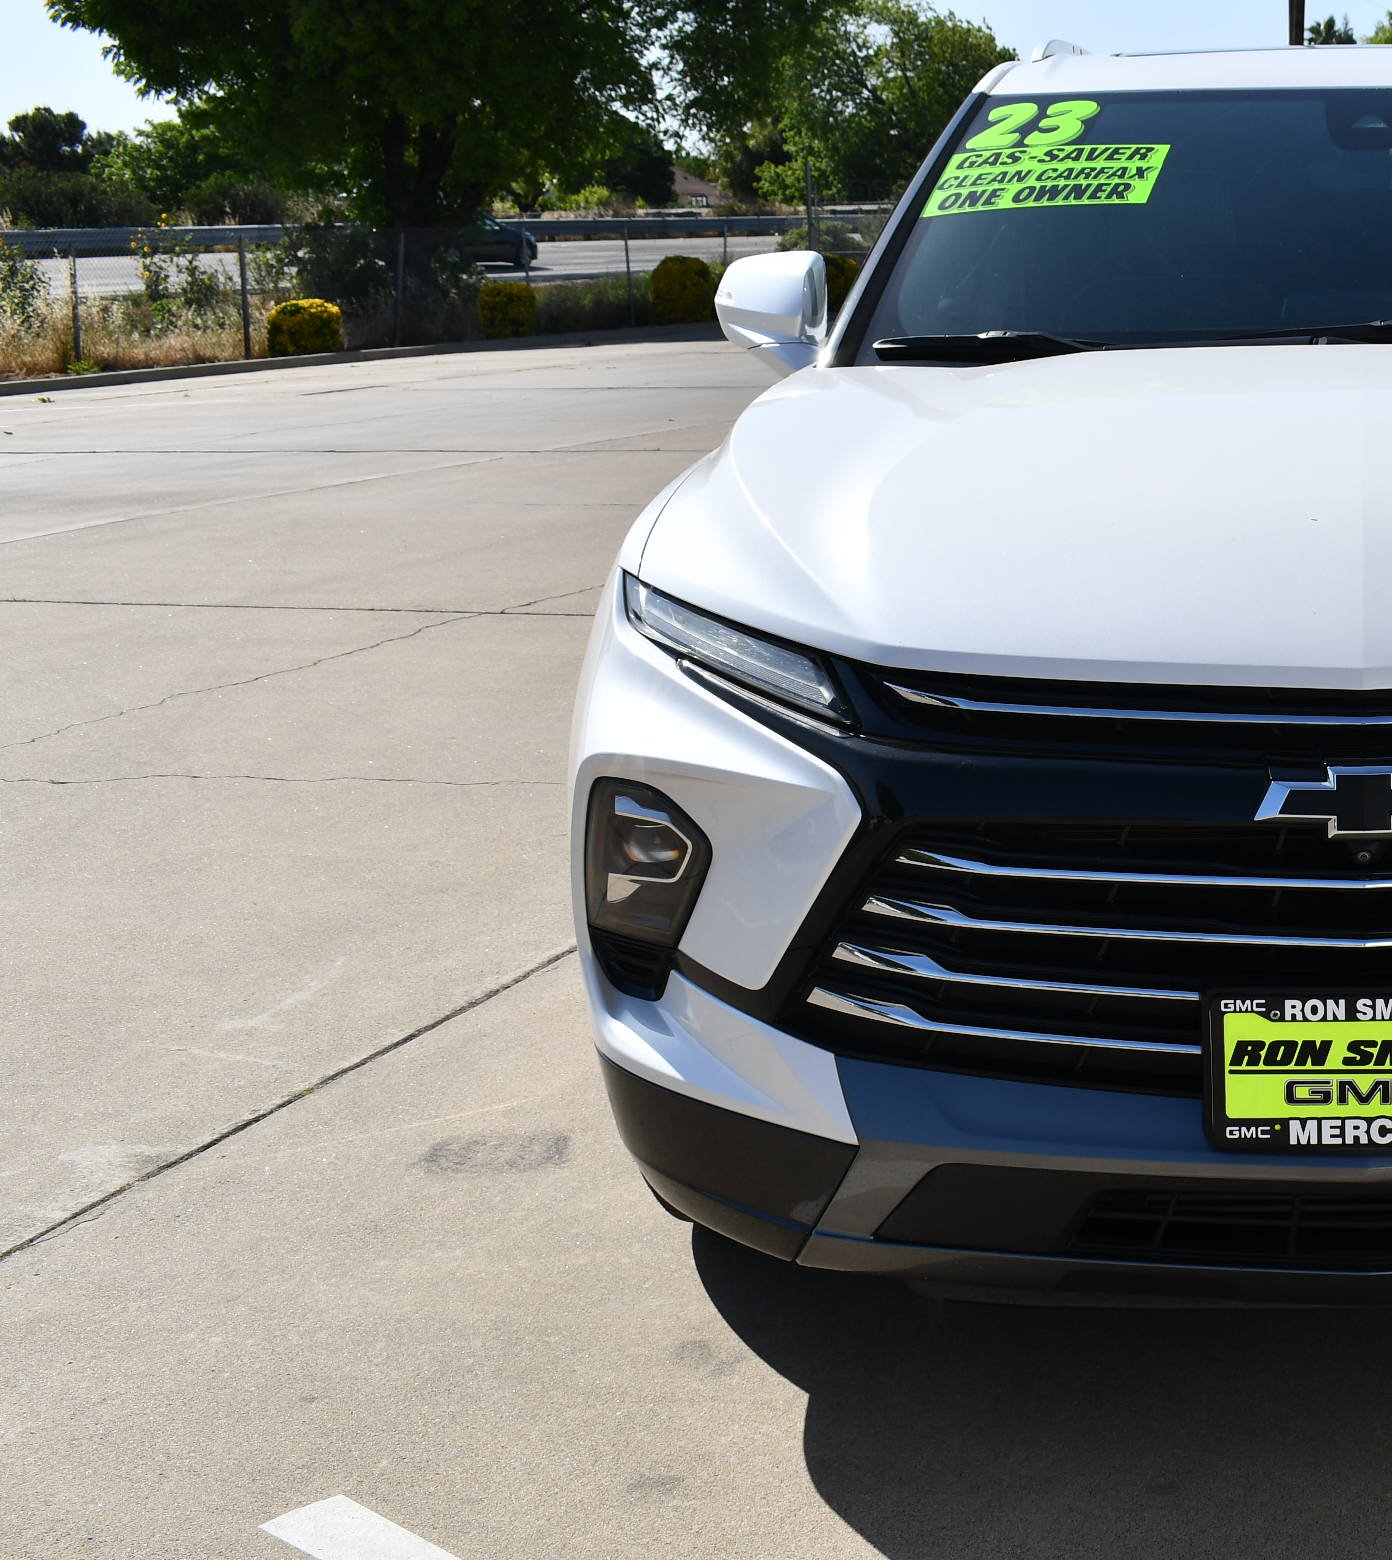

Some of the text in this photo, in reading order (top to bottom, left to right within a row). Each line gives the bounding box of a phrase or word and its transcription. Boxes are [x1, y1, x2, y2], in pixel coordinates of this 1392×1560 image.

[966, 100, 1100, 149] 23
[956, 146, 1160, 171] GAS-SAVER
[937, 165, 1157, 191] CLEAN CARFAX
[937, 182, 1135, 212] ONE OWNER
[1220, 999, 1266, 1012] GMC
[1284, 999, 1346, 1021] RON
[1228, 1040, 1333, 1067] RON
[1225, 1126, 1271, 1139] GMC
